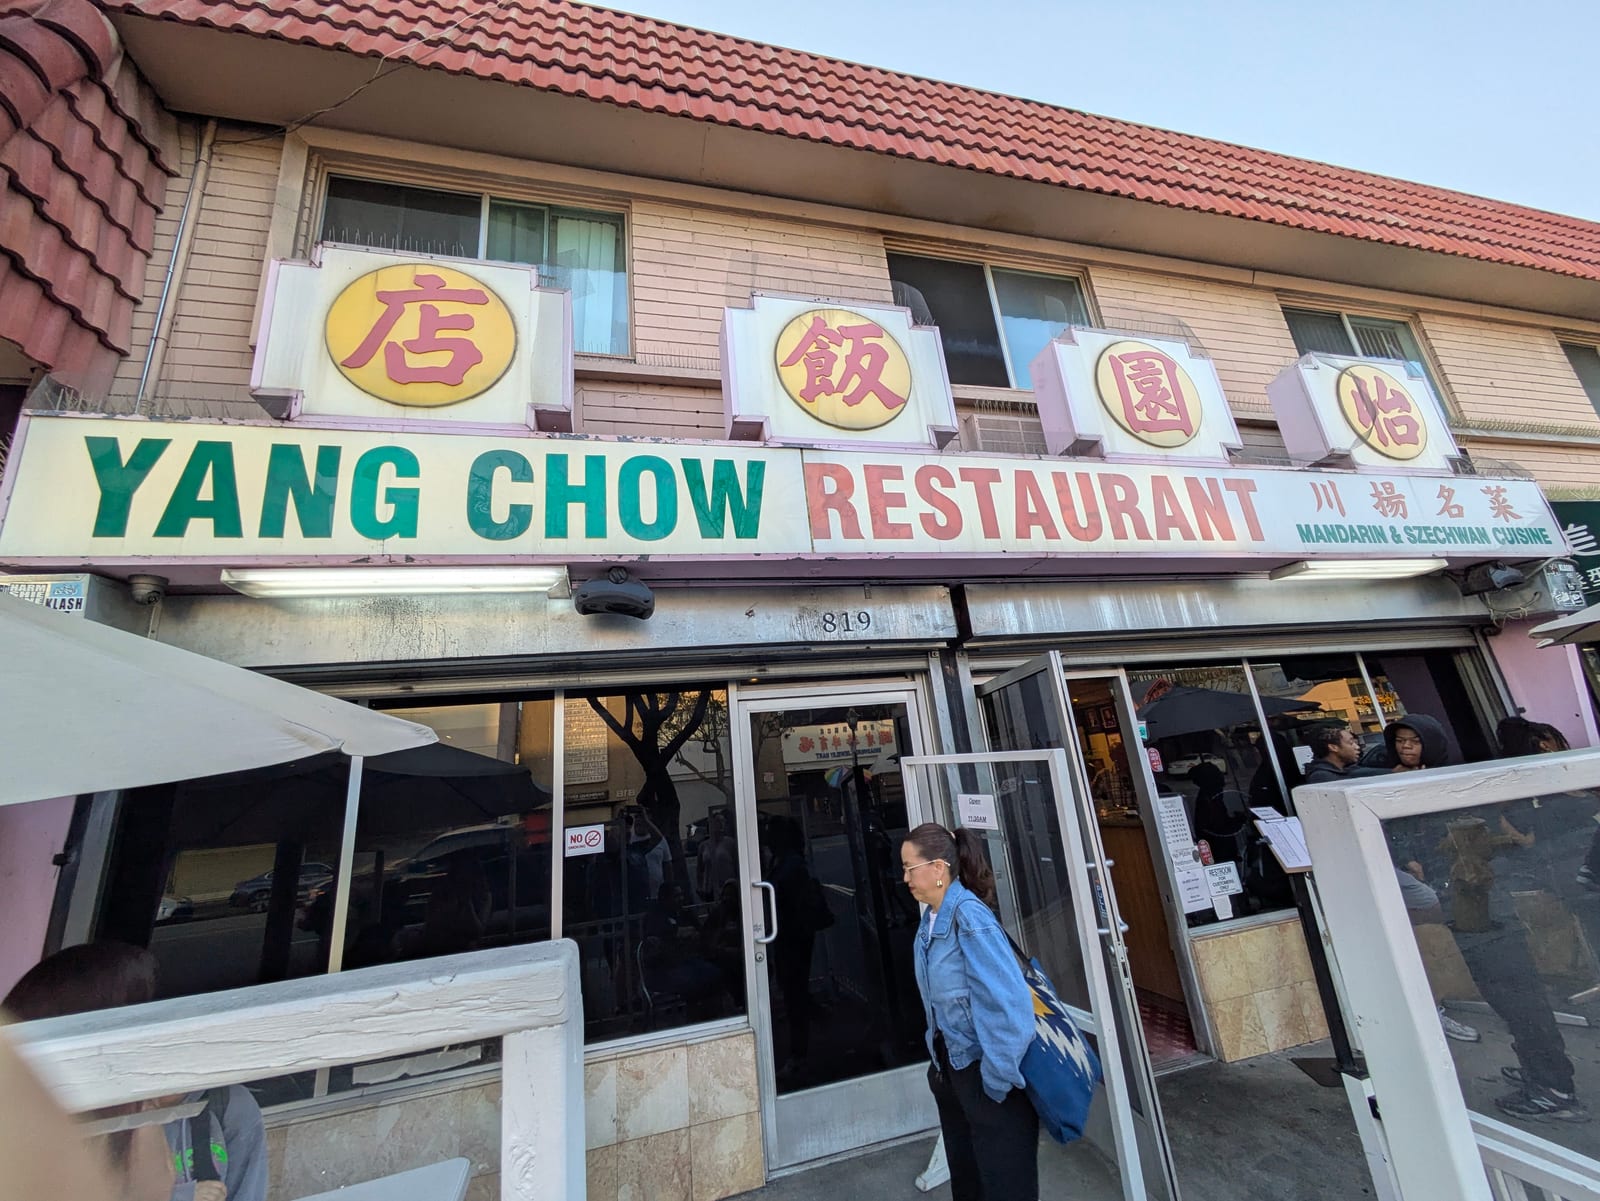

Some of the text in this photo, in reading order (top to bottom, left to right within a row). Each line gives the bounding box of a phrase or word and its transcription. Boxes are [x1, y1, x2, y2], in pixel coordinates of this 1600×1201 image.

[341, 273, 489, 386] 店
[779, 316, 912, 411] 飯
[1110, 350, 1193, 438] 園
[1354, 375, 1421, 447] 怡
[84, 435, 1264, 542] YANG CHOW RESTAURANT
[1296, 523, 1389, 544] MANDARIN
[1390, 526, 1404, 544] &
[1403, 525, 1492, 545] SZECHWAN
[1492, 527, 1553, 545] CUISINE
[45, 598, 83, 610] KLASH
[822, 611, 871, 633] 819
[570, 833, 583, 844] NO
